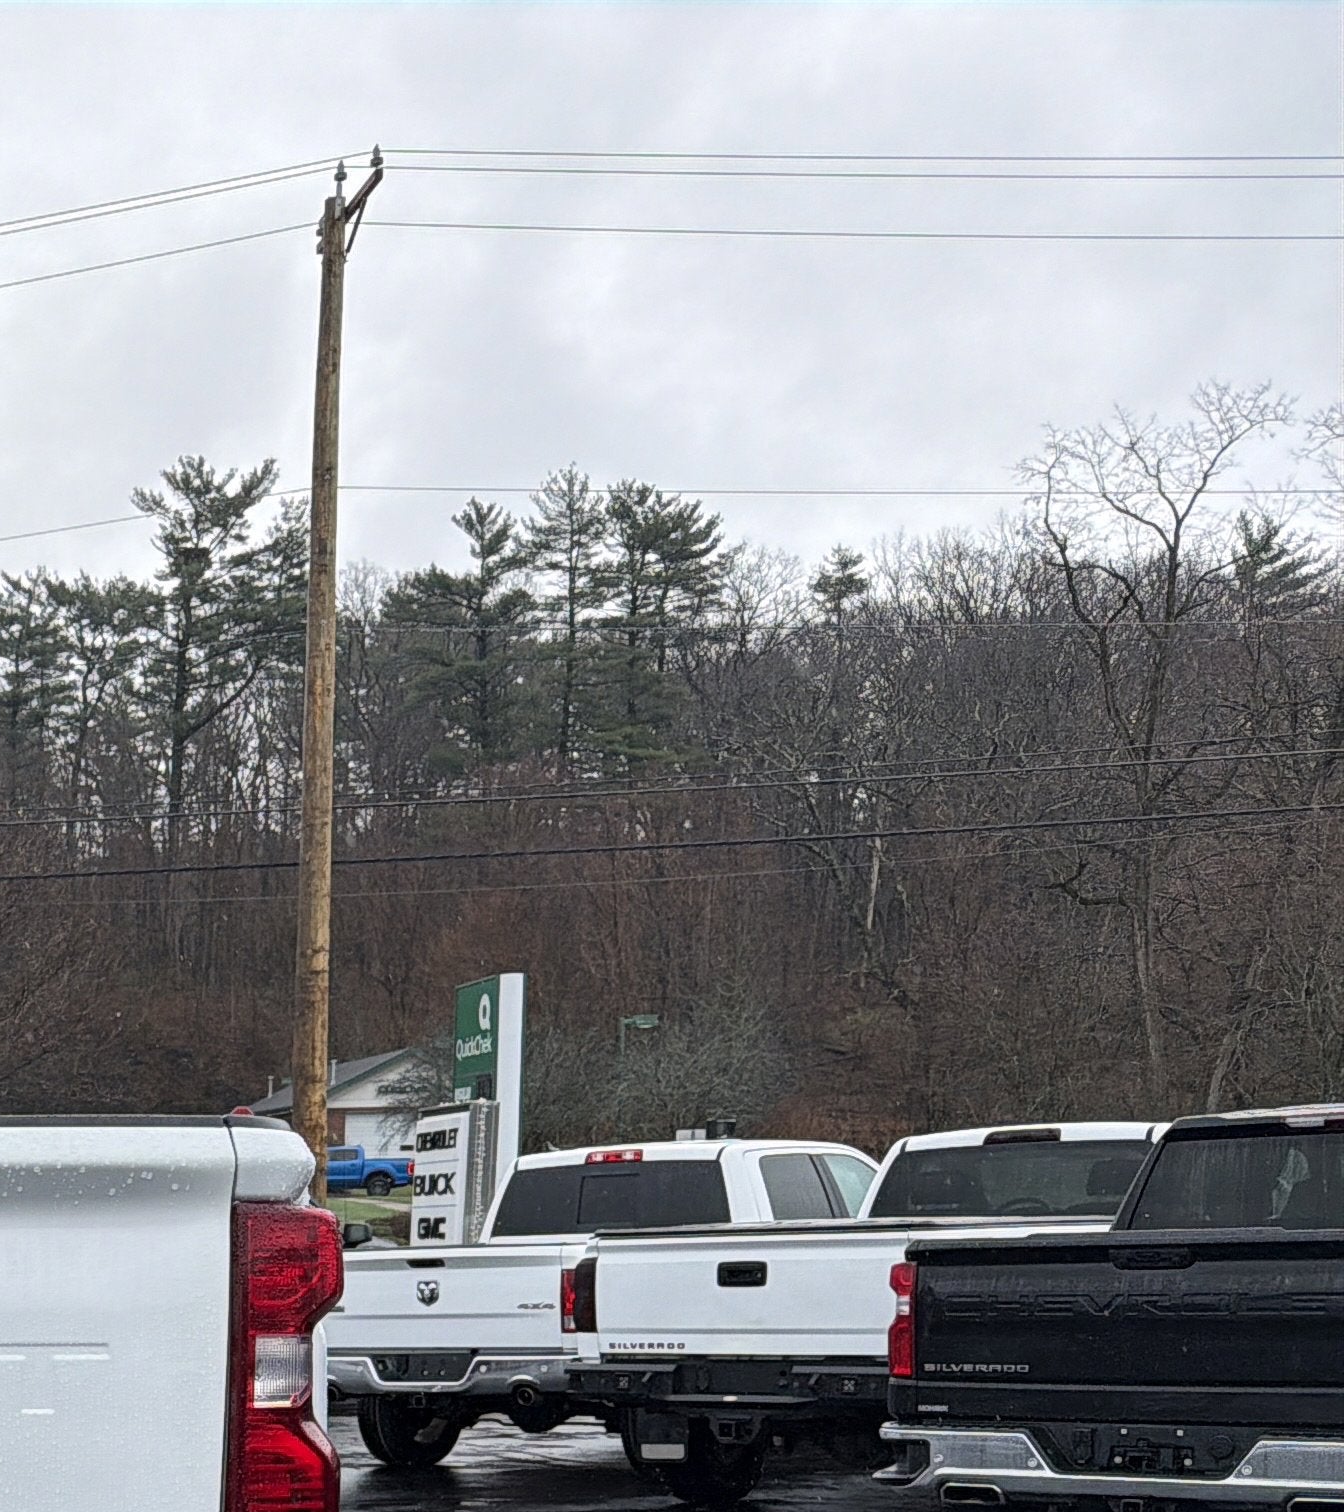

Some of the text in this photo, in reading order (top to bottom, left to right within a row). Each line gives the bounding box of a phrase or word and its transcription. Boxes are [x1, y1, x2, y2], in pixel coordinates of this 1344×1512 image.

[413, 1172, 456, 1196] BUICK
[417, 1217, 446, 1240] GMC
[609, 1342, 686, 1350] SILVERADO
[924, 1363, 1030, 1373] SILVERADO
